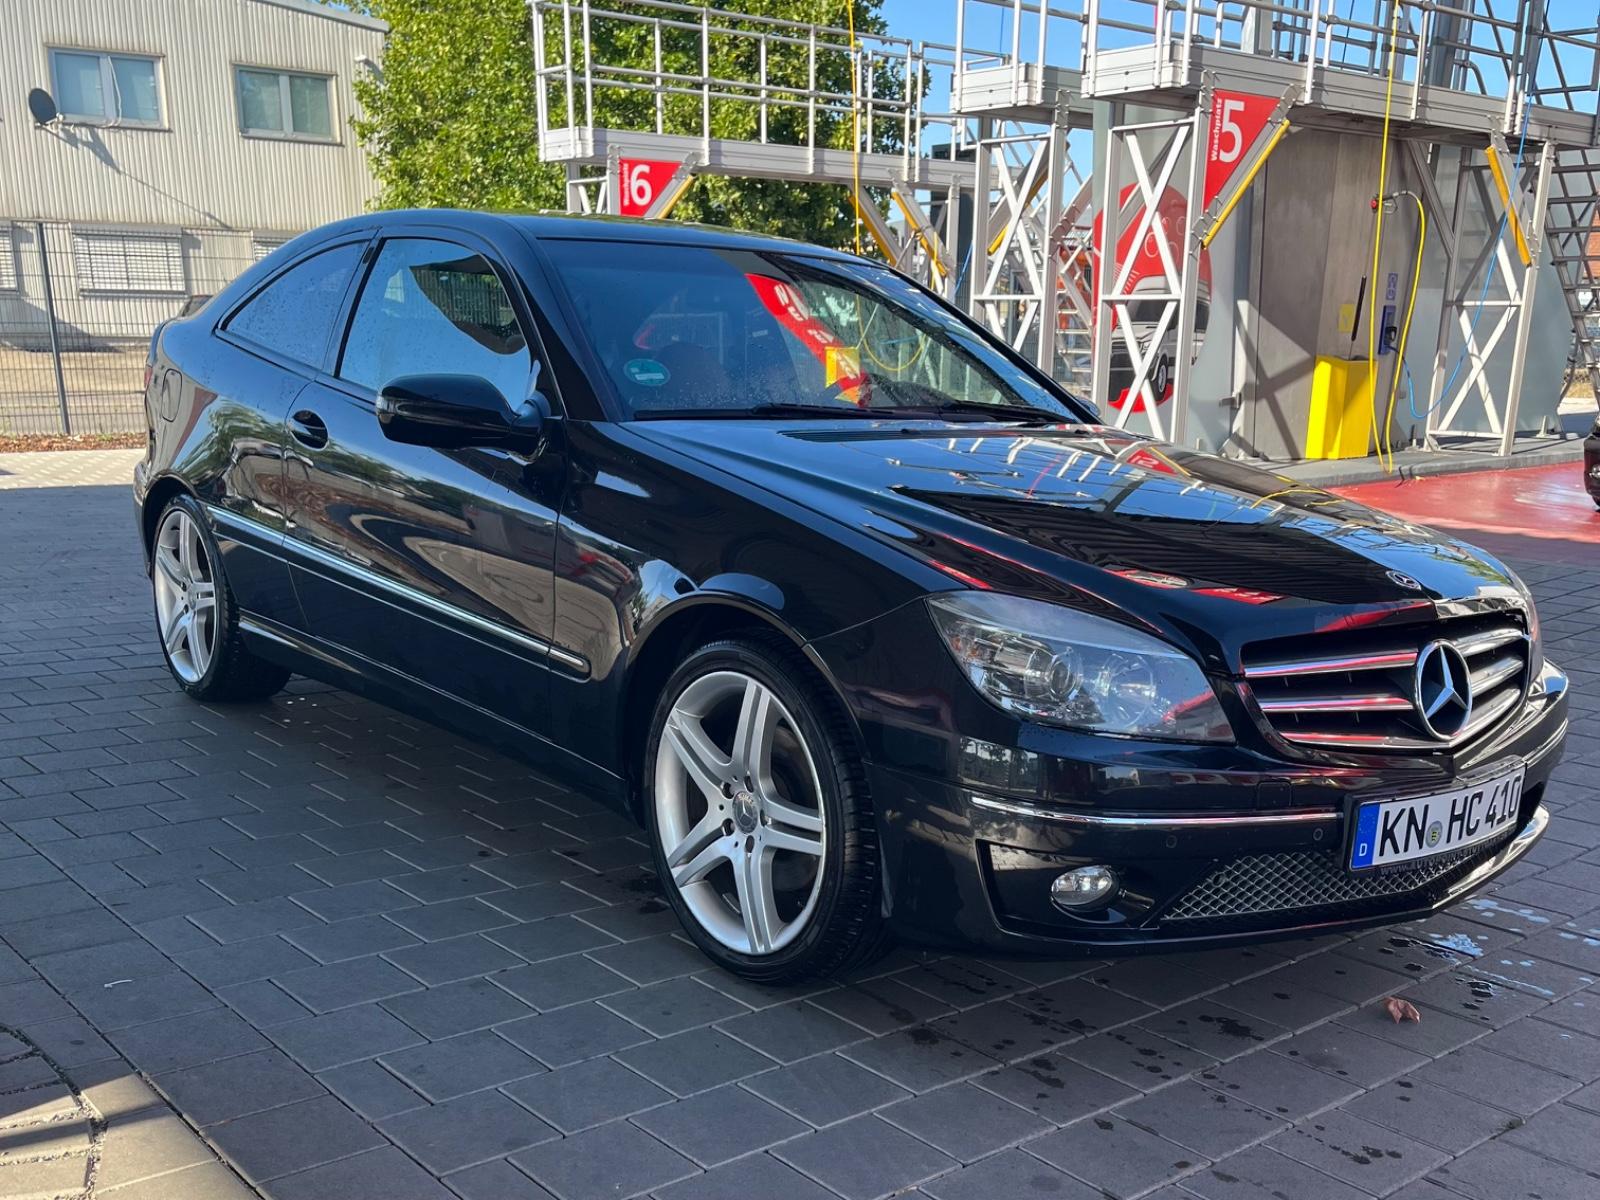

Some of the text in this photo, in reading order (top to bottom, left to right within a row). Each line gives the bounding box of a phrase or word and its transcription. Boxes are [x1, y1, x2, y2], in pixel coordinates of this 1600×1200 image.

[1210, 98, 1223, 161] Waschplatz
[1219, 99, 1245, 163] 5
[630, 164, 652, 206] 6
[1379, 804, 1429, 857] KN
[1446, 791, 1484, 844] HC
[1485, 775, 1521, 829] 410
[1359, 843, 1368, 857] D
